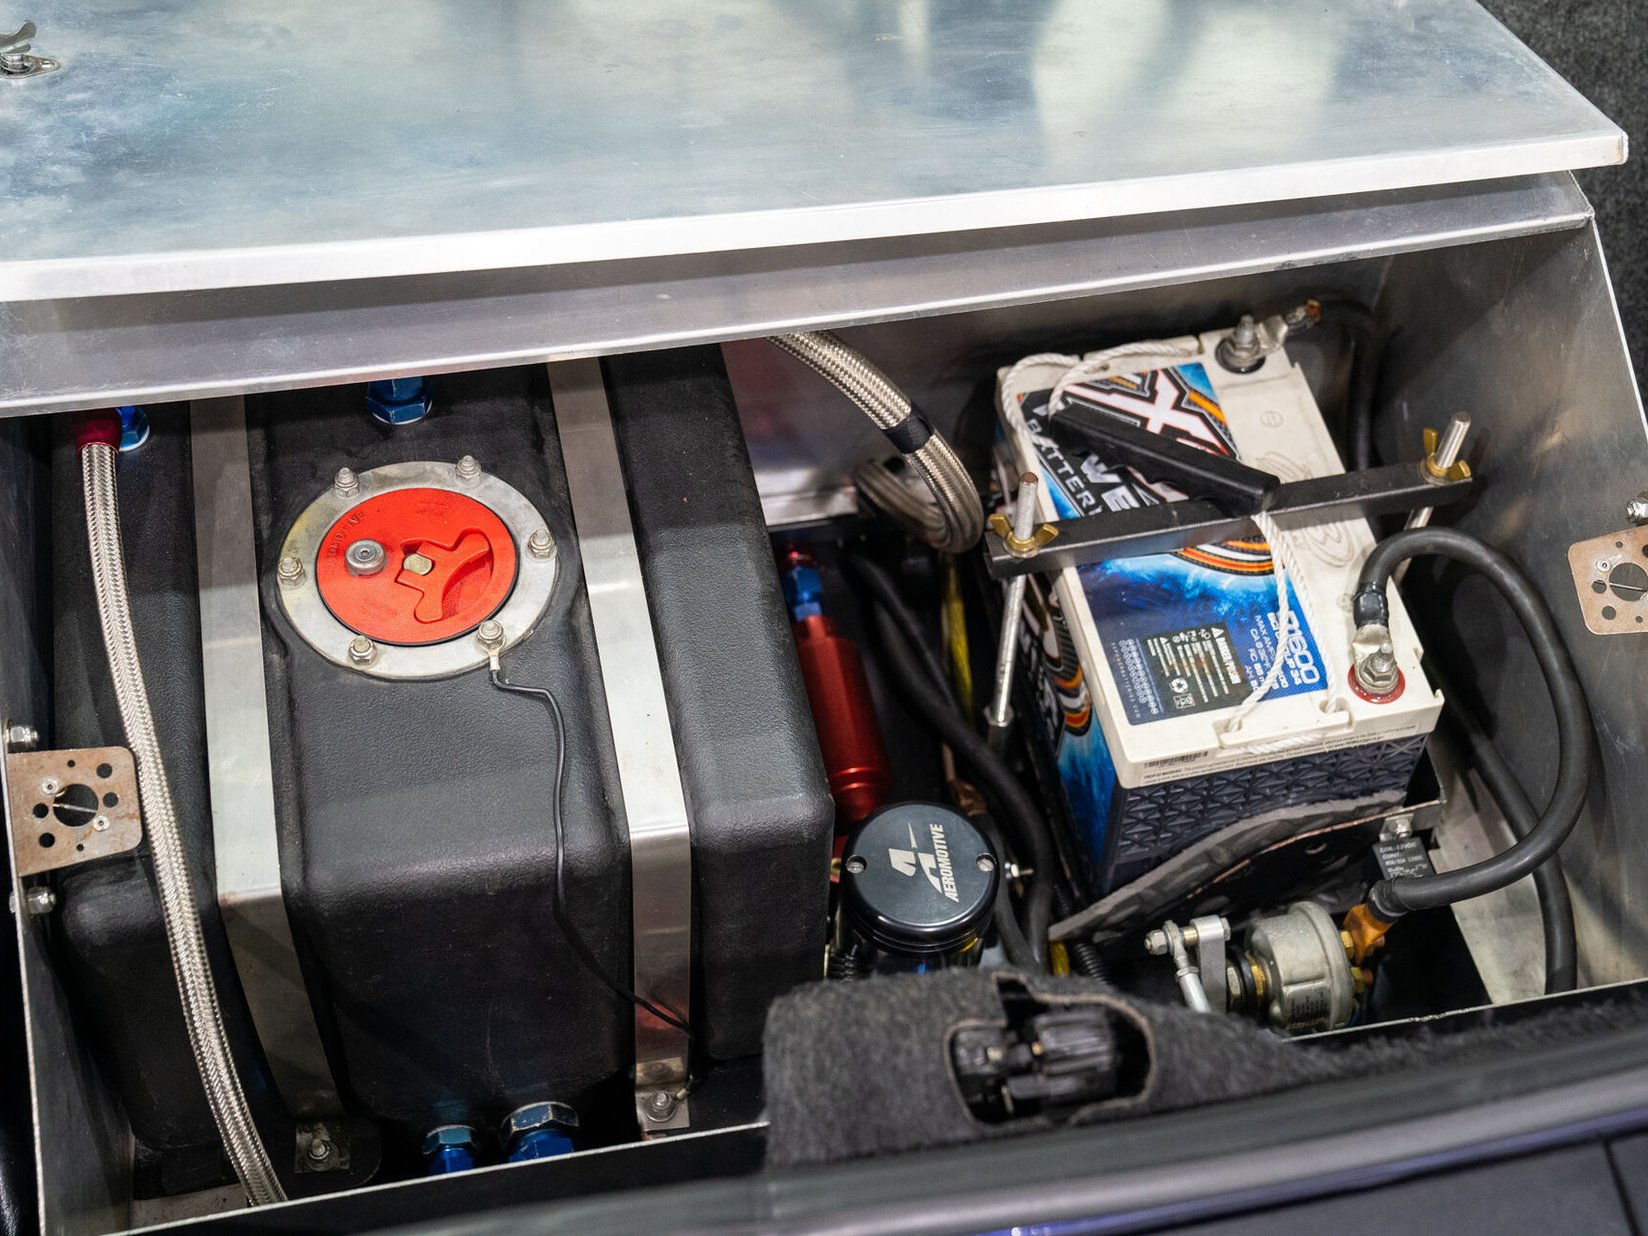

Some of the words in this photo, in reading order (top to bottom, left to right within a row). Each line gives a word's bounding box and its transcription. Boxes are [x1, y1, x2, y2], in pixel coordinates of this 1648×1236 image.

[1024, 418, 1102, 516] BTTER
[1255, 614, 1268, 636] MAX
[929, 822, 961, 904] AEROMOTIVE
